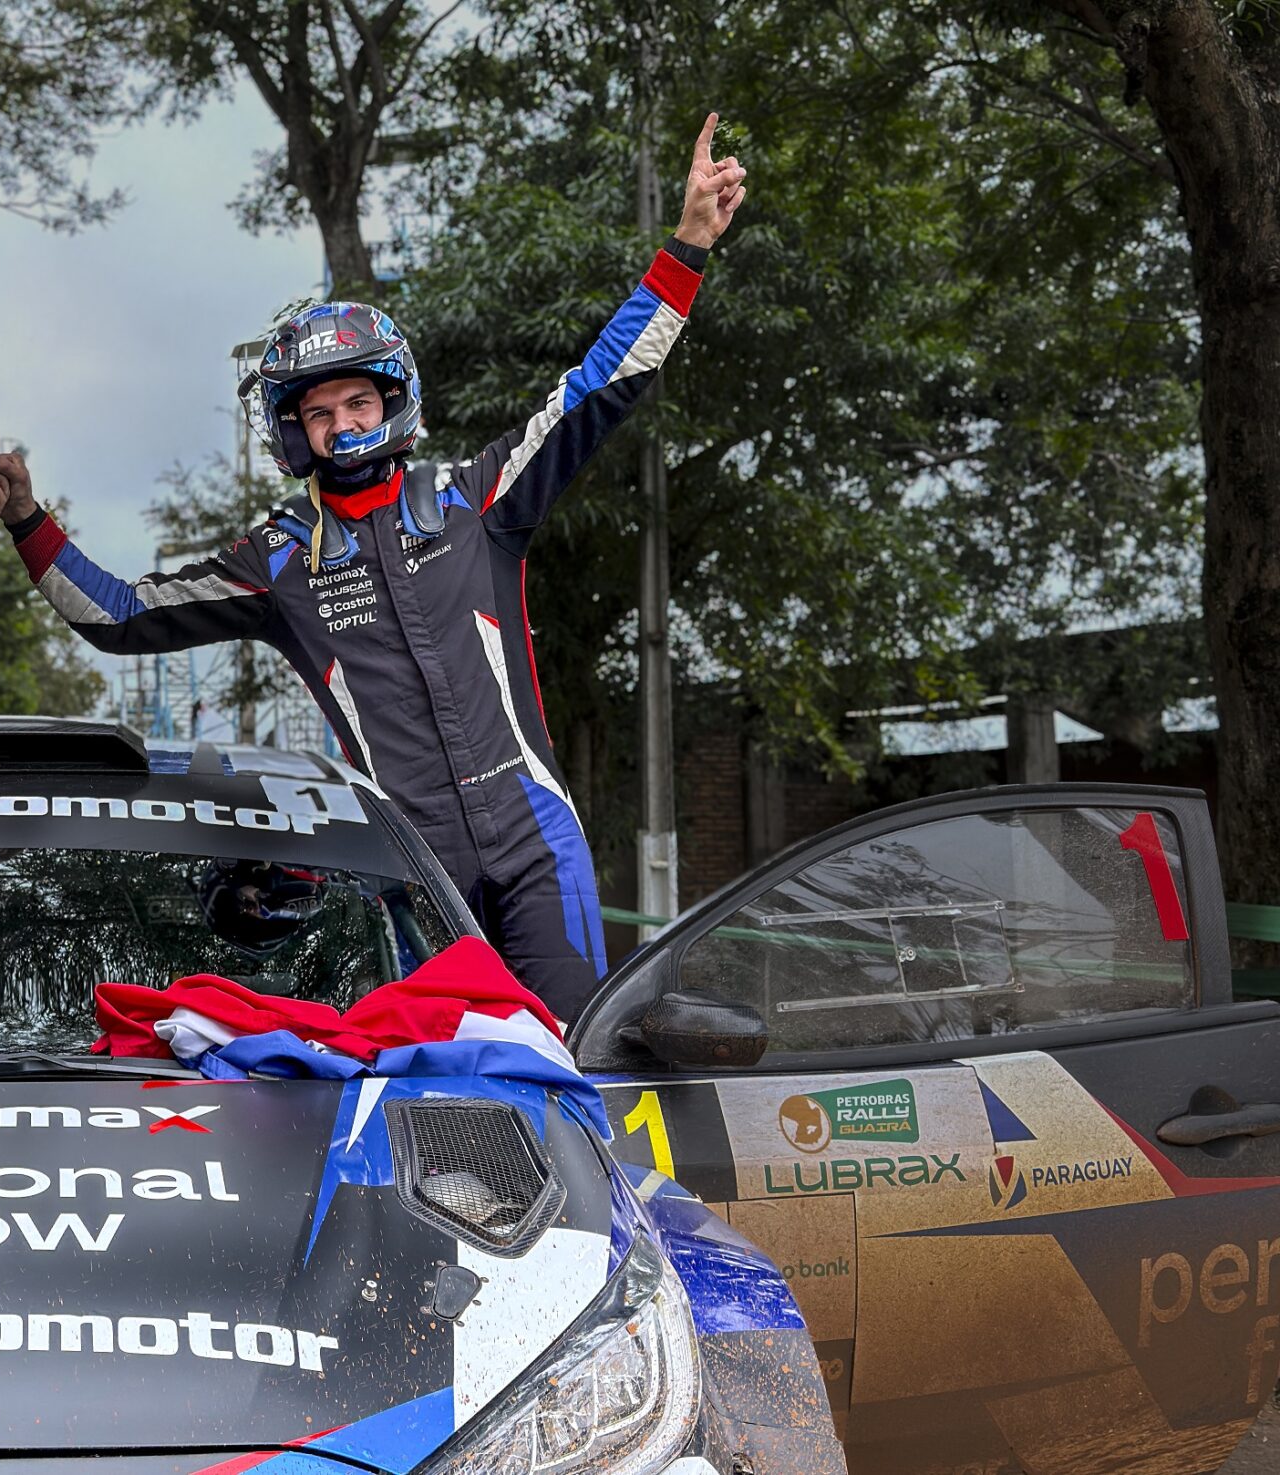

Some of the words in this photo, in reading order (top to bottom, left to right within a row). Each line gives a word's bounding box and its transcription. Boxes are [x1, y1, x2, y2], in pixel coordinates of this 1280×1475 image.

[268, 532, 288, 544] OM
[419, 543, 452, 565] PARAGUAY
[320, 580, 373, 600] PLUSCAR
[333, 594, 377, 613] Castrol
[326, 612, 376, 634] TOPTUL
[295, 787, 328, 812] 1
[1120, 812, 1189, 941] 1
[836, 1093, 911, 1107] PETROBRAS
[837, 1105, 910, 1122] RALLY
[624, 1091, 675, 1180] 1
[839, 1120, 912, 1135] GUAIRÁ
[1032, 1157, 1133, 1188] PARAGUAY
[799, 1256, 850, 1278] bank
[1137, 1237, 1280, 1348] per
